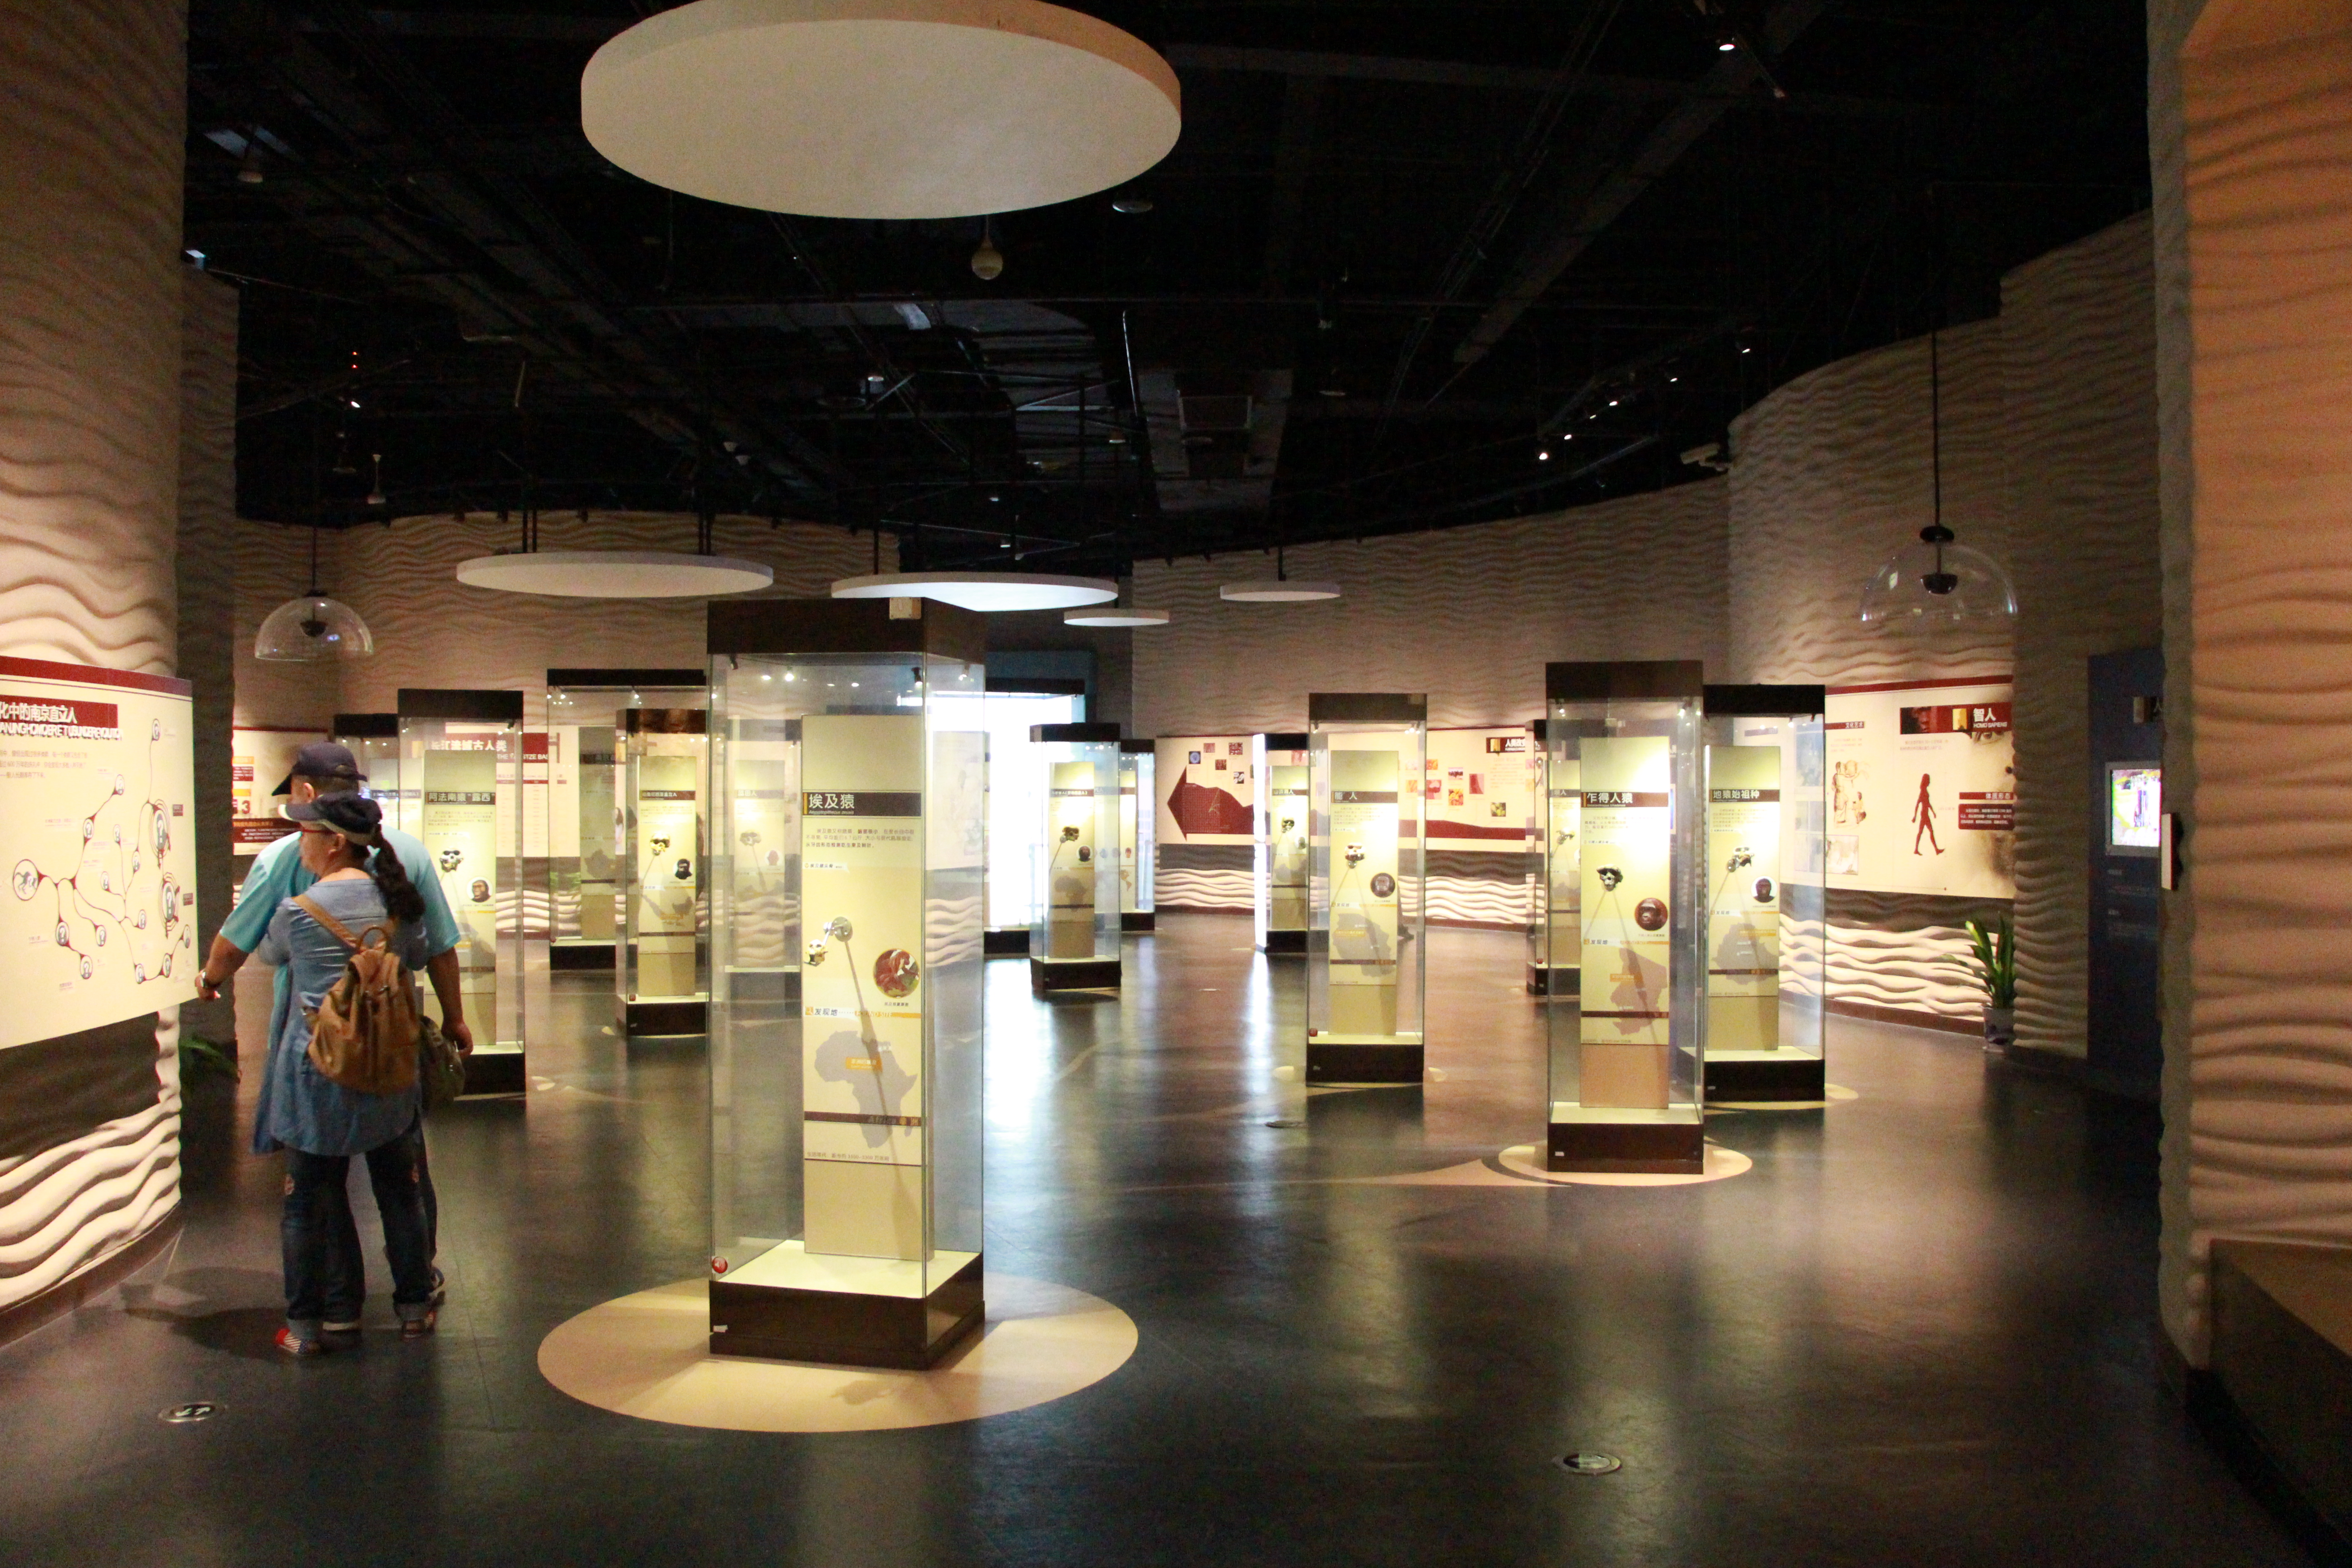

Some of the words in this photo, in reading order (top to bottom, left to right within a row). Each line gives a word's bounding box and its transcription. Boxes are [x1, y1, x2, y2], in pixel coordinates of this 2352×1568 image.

[1973, 708, 1996, 722] 智人
[431, 740, 507, 751] 长江流域古人类
[1587, 792, 1633, 804] 乍得人猿
[1713, 790, 1759, 799] 地猿始祖种
[809, 794, 855, 808] 埃及猿
[814, 1008, 838, 1016] 发现地
